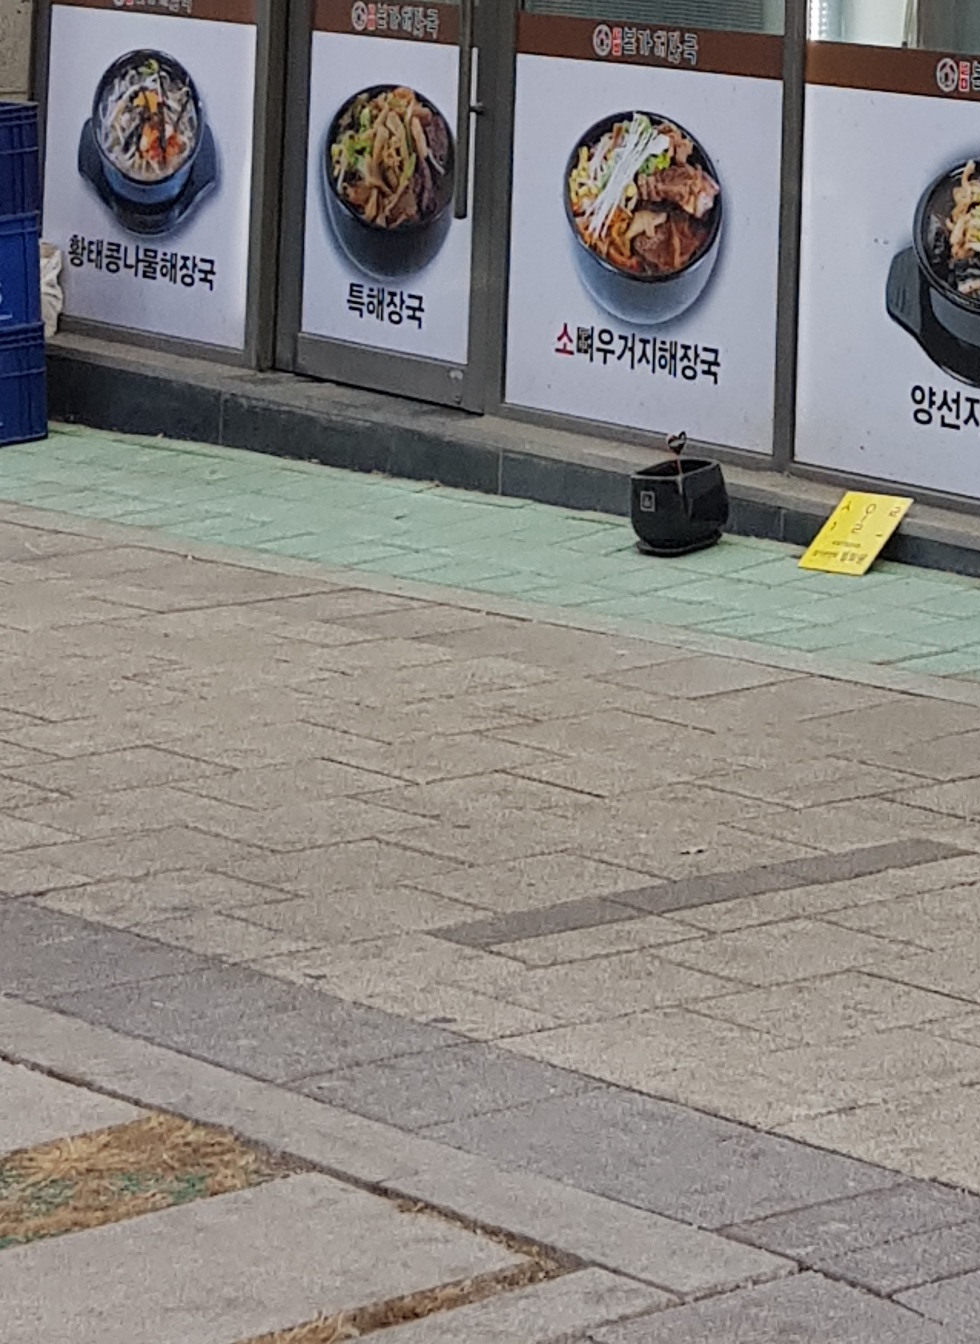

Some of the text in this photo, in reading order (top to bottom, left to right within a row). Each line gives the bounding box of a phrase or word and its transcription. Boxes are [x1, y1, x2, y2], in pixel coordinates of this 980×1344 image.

[67, 233, 217, 292] 황태콩나물해장국
[345, 281, 426, 330] 특해장국
[554, 321, 722, 386] 소뼈우거지해장국
